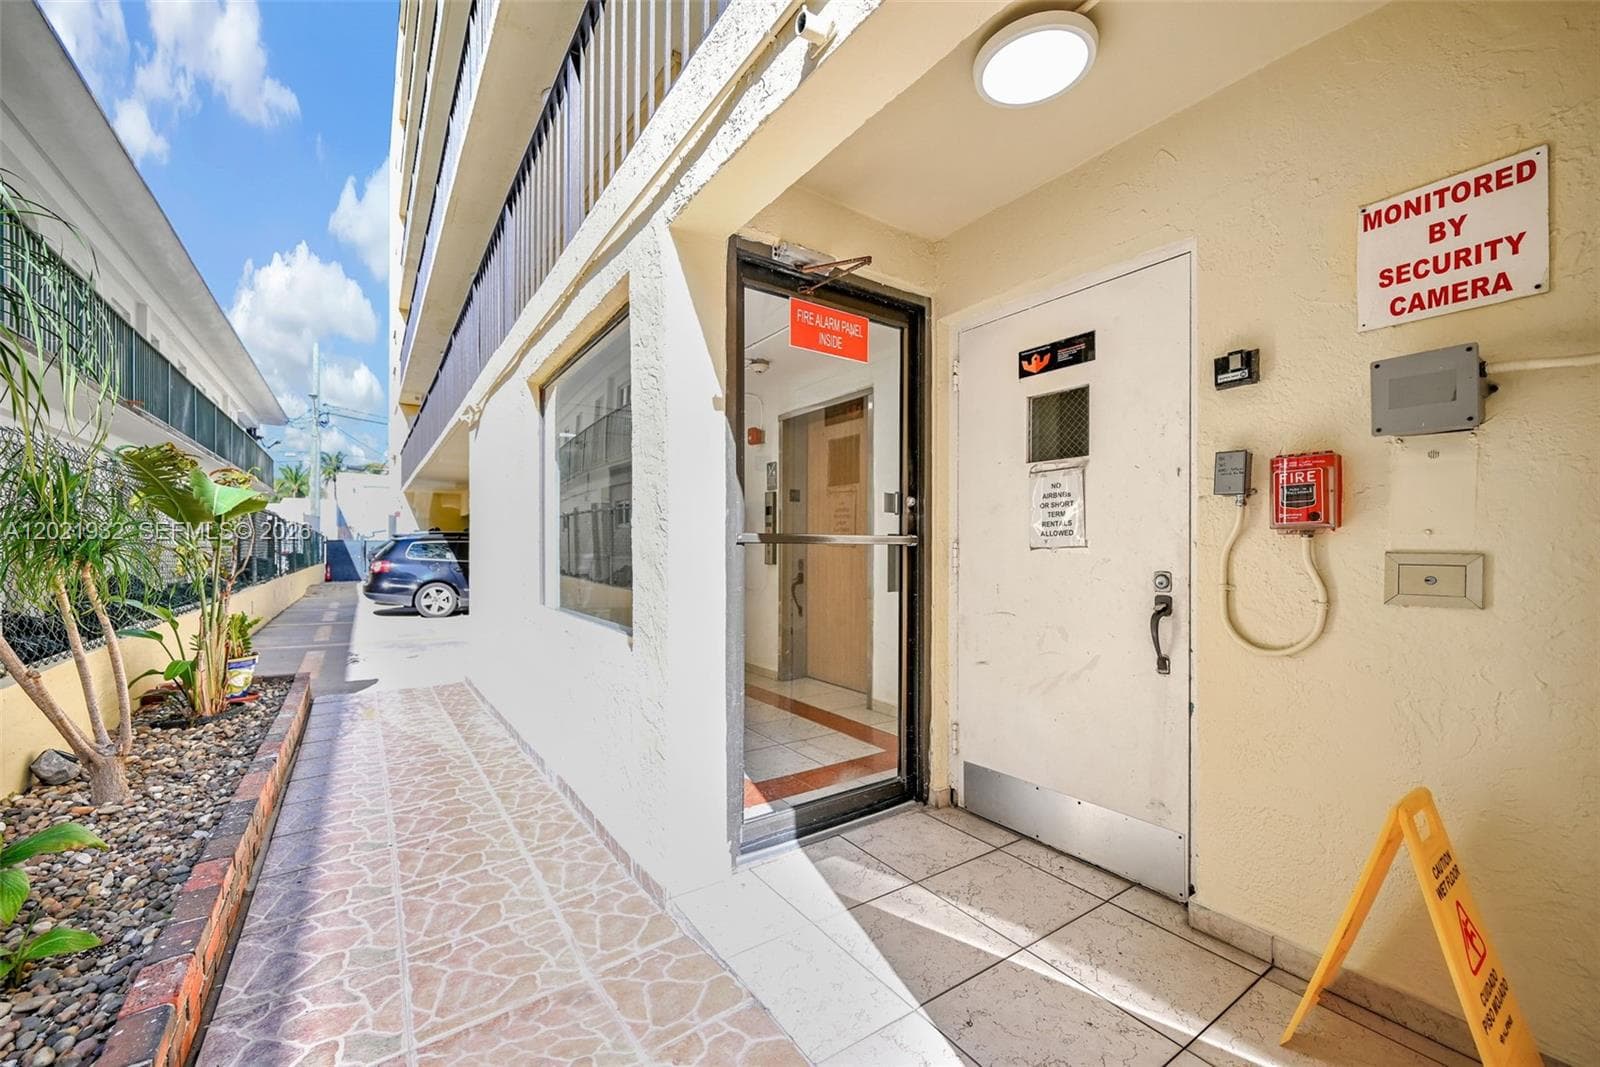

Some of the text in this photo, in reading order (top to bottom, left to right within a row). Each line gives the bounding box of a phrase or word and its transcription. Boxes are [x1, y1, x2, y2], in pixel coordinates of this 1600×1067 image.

[1363, 159, 1537, 232] MONITORED
[1429, 214, 1468, 244] BY
[1378, 231, 1526, 289] SECURITY
[1390, 272, 1513, 317] CAMERA
[796, 308, 863, 338] FIRE ALARM PANEL
[818, 332, 843, 350] INSIDE
[1279, 470, 1316, 484] FIRE
[1050, 500, 1074, 508] SHORT
[1040, 529, 1074, 537] ALLOWED
[1432, 849, 1453, 880] CAUTION
[1435, 864, 1461, 901] WET FLOOR
[1480, 968, 1498, 1007] CUIDADO
[1482, 1007, 1496, 1035] PISO
[1491, 977, 1508, 1016] MOJADO
